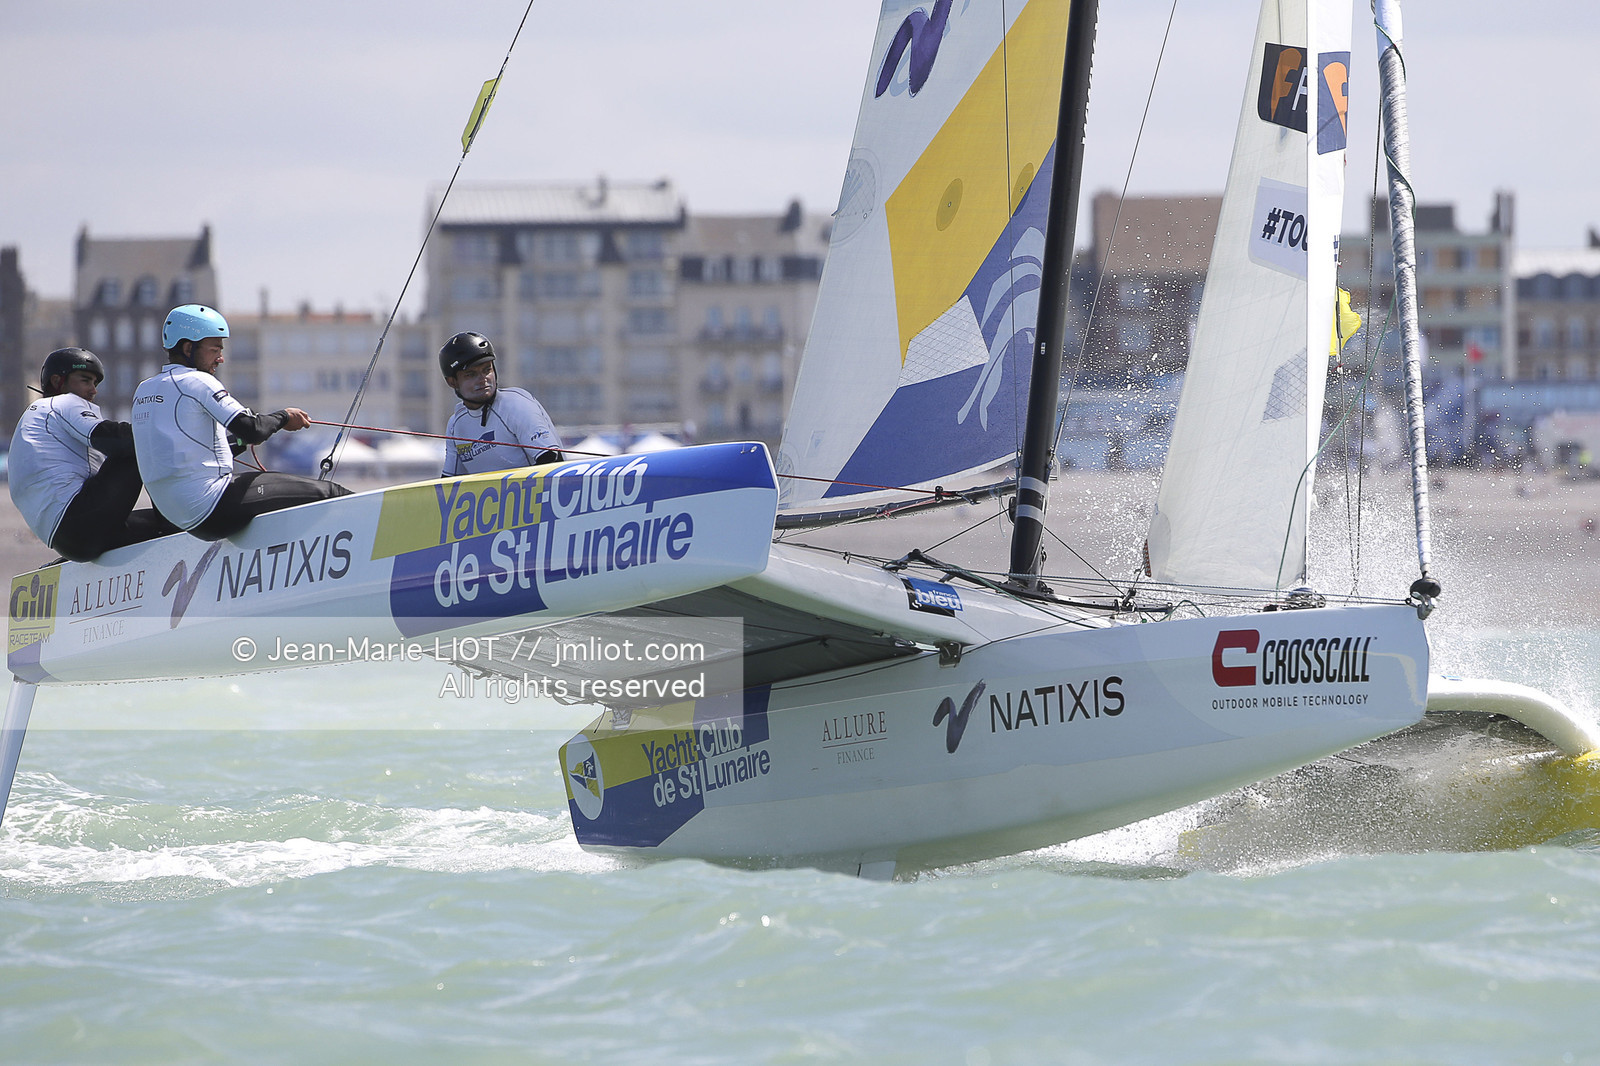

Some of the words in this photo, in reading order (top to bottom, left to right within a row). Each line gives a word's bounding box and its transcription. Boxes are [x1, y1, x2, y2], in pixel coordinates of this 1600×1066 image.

[434, 456, 648, 544] Yacht-Club
[216, 530, 354, 602] NATIXIS
[434, 542, 479, 608] de
[488, 529, 531, 595] St
[544, 512, 694, 584] Lunaire
[9, 574, 54, 623] Gill
[69, 570, 145, 616] ALLURE
[915, 588, 961, 610] bleu
[82, 620, 125, 644] FINANCE
[1262, 636, 1371, 685] CROSSCALL
[822, 711, 887, 742] ALLURE
[989, 675, 1125, 733] NATIXIS
[1212, 697, 1258, 710] OUTDOOR
[1262, 696, 1299, 707] MOBILE
[1303, 694, 1369, 706] TECHNOLOGY
[641, 717, 742, 776] Yacht-Club
[837, 748, 875, 765] FINANCE
[653, 772, 676, 808] de
[678, 763, 700, 799] St
[703, 744, 771, 793] Lunaire
